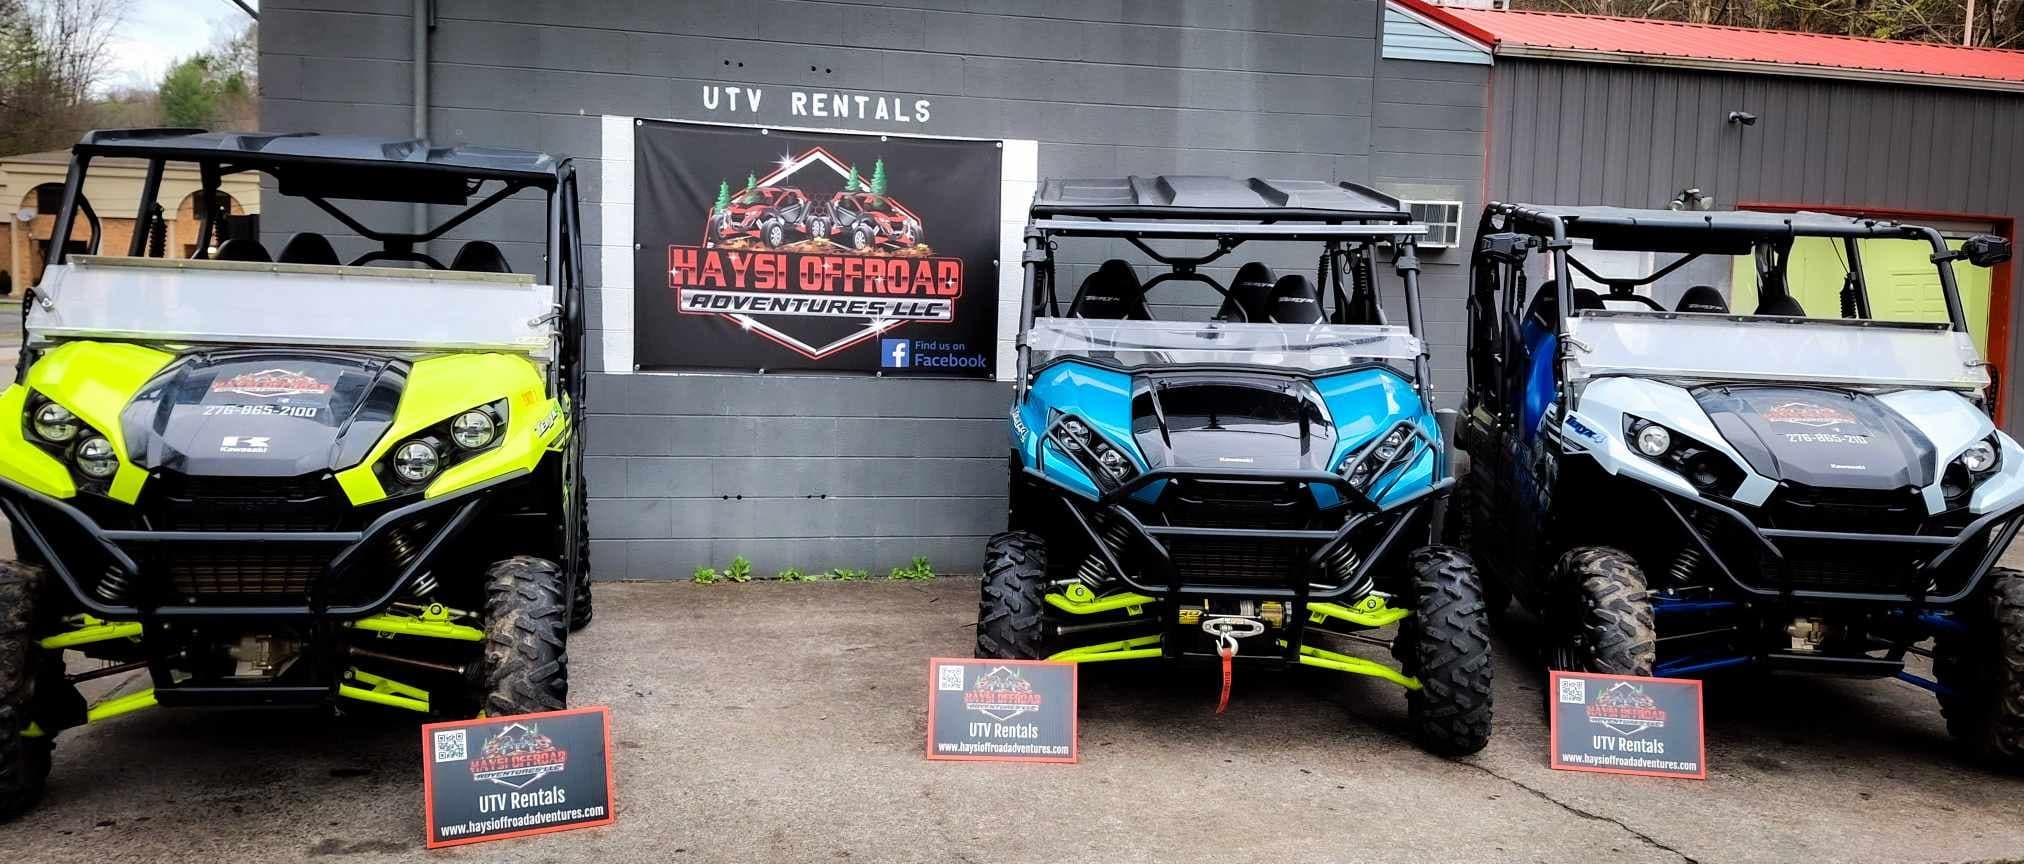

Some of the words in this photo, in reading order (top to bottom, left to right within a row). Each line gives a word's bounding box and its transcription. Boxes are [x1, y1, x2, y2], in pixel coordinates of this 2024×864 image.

[703, 86, 762, 112] UTV
[791, 92, 930, 122] RENTALS
[671, 248, 787, 289] HAYSI
[799, 254, 960, 296] OFFROAD
[689, 294, 887, 316] ADVENTURES
[891, 301, 944, 317] LLC
[915, 341, 937, 351] Find
[939, 343, 950, 351] us
[953, 343, 966, 351] on
[914, 353, 987, 368] Facebook
[203, 404, 318, 418] 276-865-2100
[969, 722, 991, 738] UTV
[994, 723, 1039, 739] Rentals
[938, 741, 1069, 755] www.haysioffroadadventures.com
[1593, 735, 1615, 751] UTV
[1618, 737, 1664, 754] Rentals
[469, 755, 509, 773] HAYSI
[511, 751, 567, 769] OFFROAD
[1562, 753, 1697, 771] www.haysioffroadadventures.com
[479, 793, 507, 813] UTV
[511, 786, 566, 809] Rentals
[440, 805, 604, 837] www.haysioffroadadventures.com
